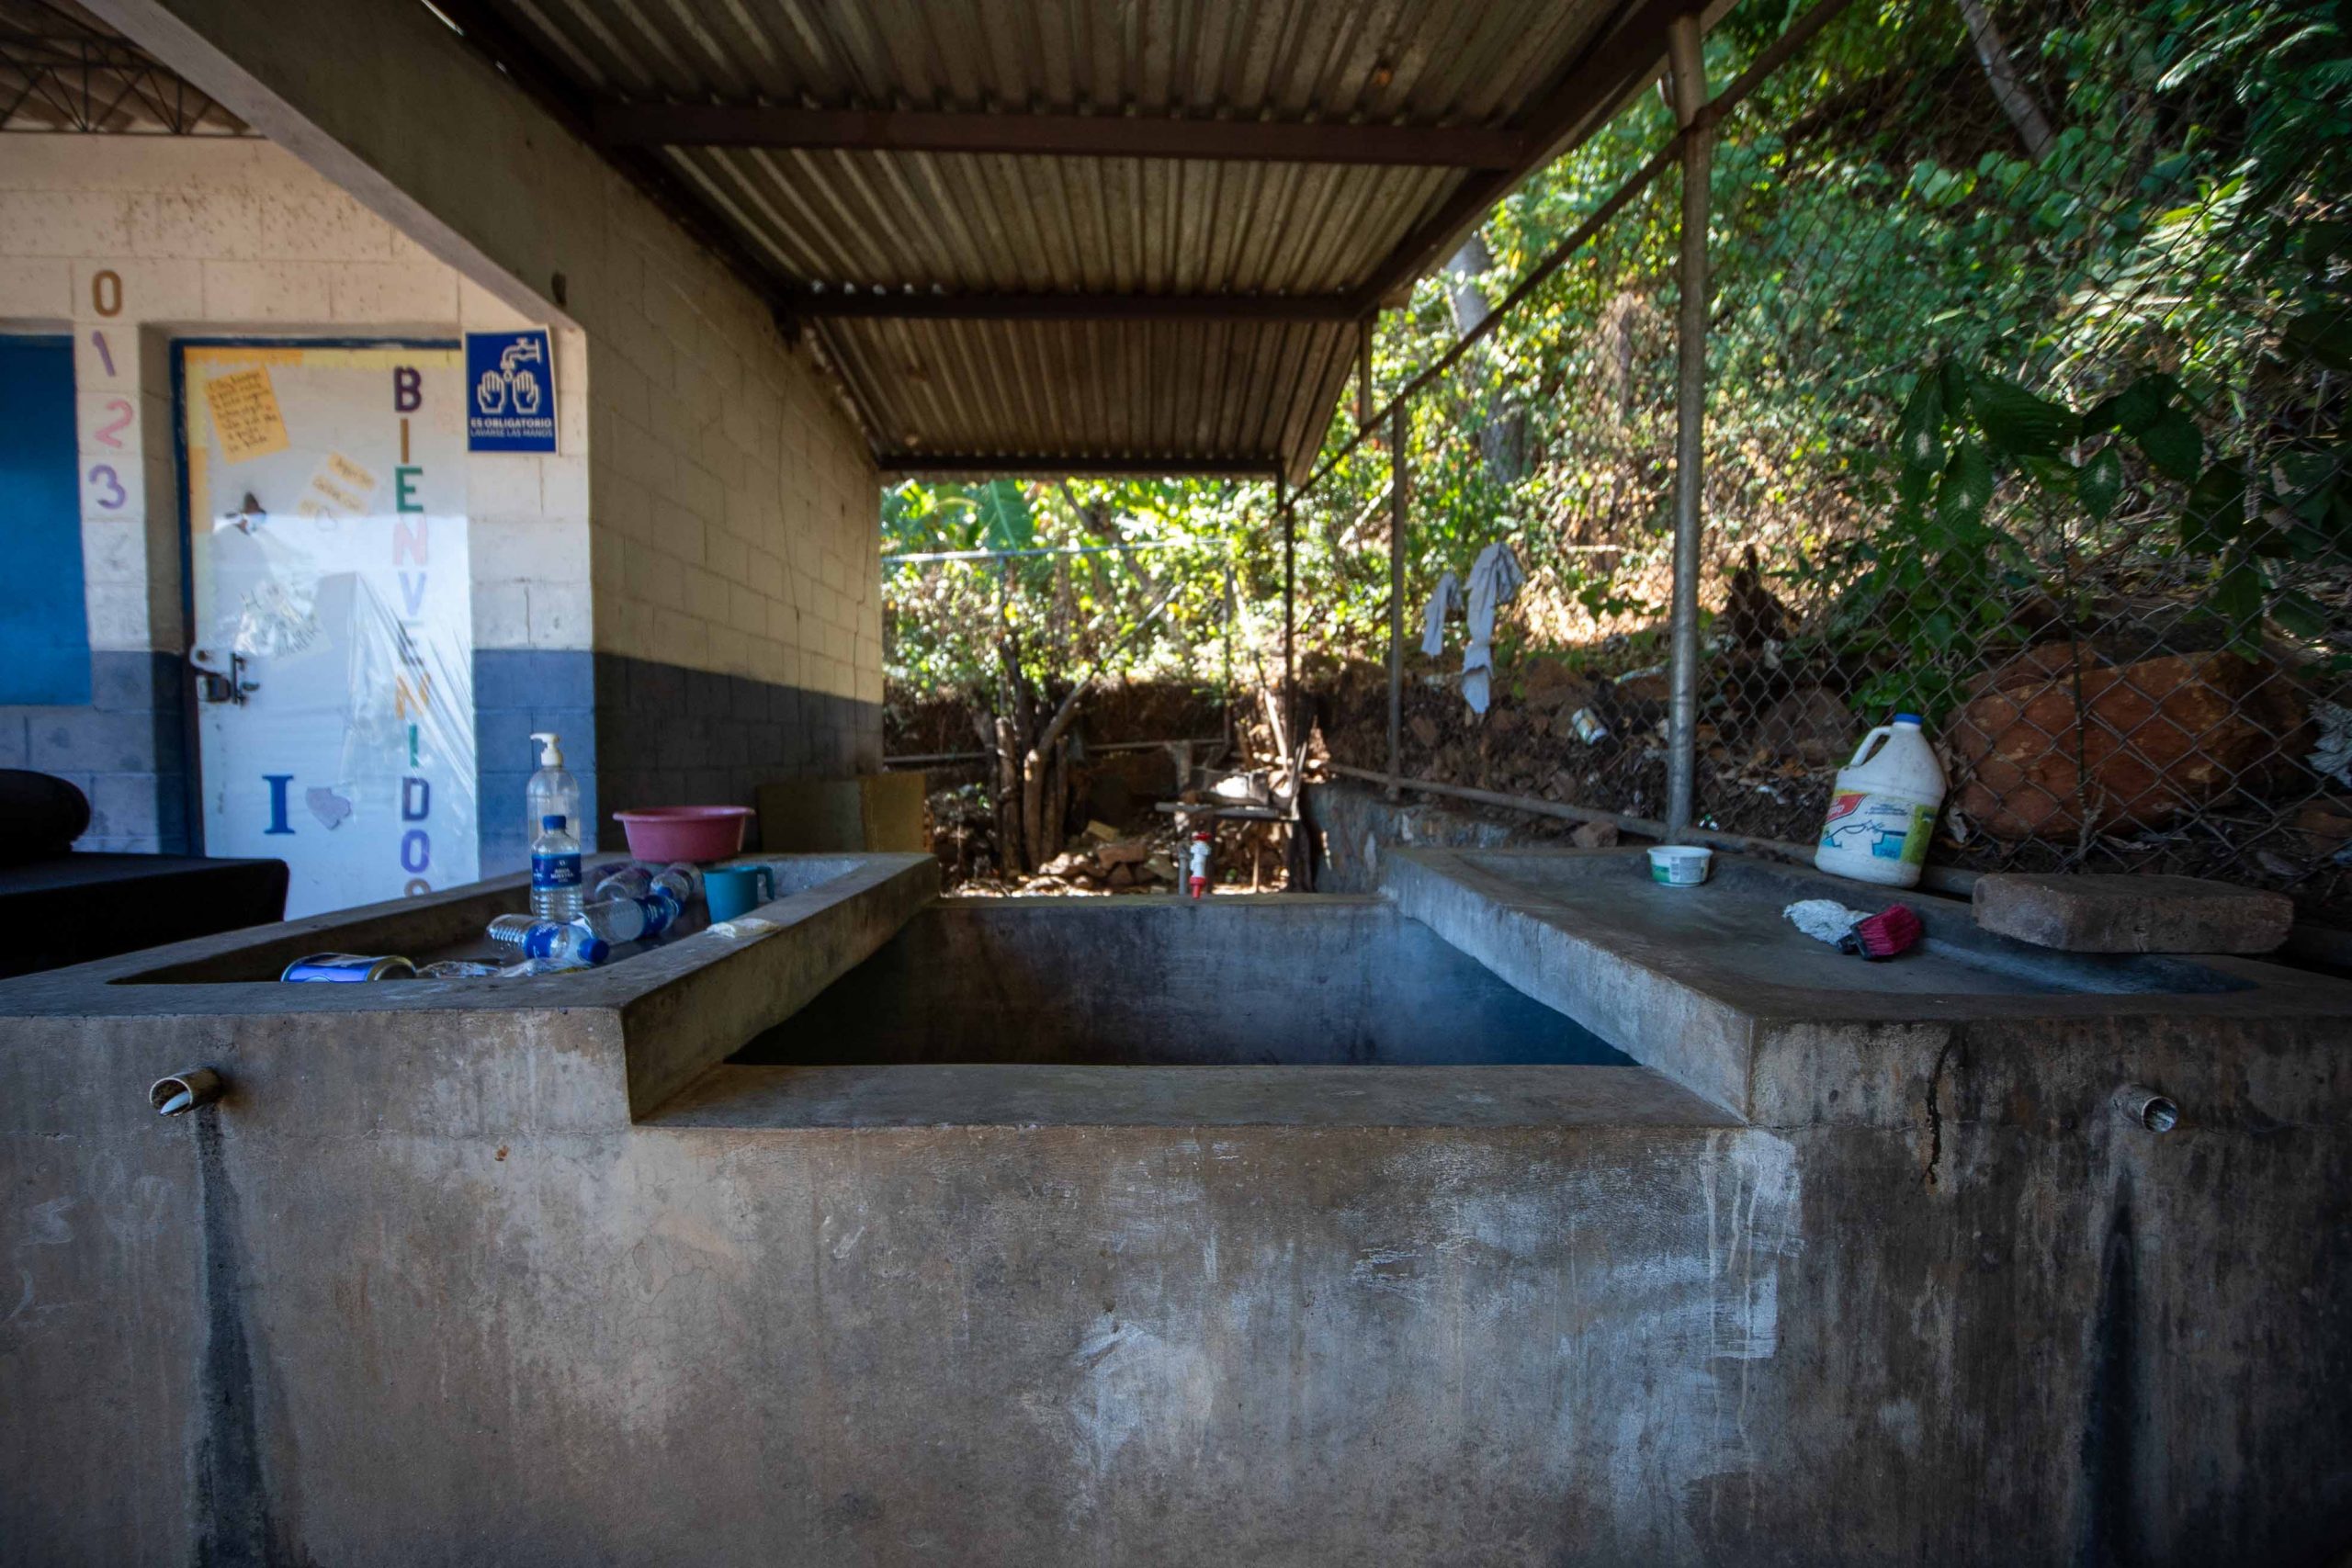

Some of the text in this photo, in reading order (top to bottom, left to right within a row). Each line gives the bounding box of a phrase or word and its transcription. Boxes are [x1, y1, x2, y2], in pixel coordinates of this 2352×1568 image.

[93, 269, 122, 318] 0
[93, 331, 116, 377] 1
[95, 398, 133, 448] 2
[469, 417, 552, 428] ES OBLIGATORIO
[506, 427, 522, 437] LAS
[523, 427, 553, 437] MANOS
[89, 465, 126, 510] 3
[261, 774, 296, 835] I
